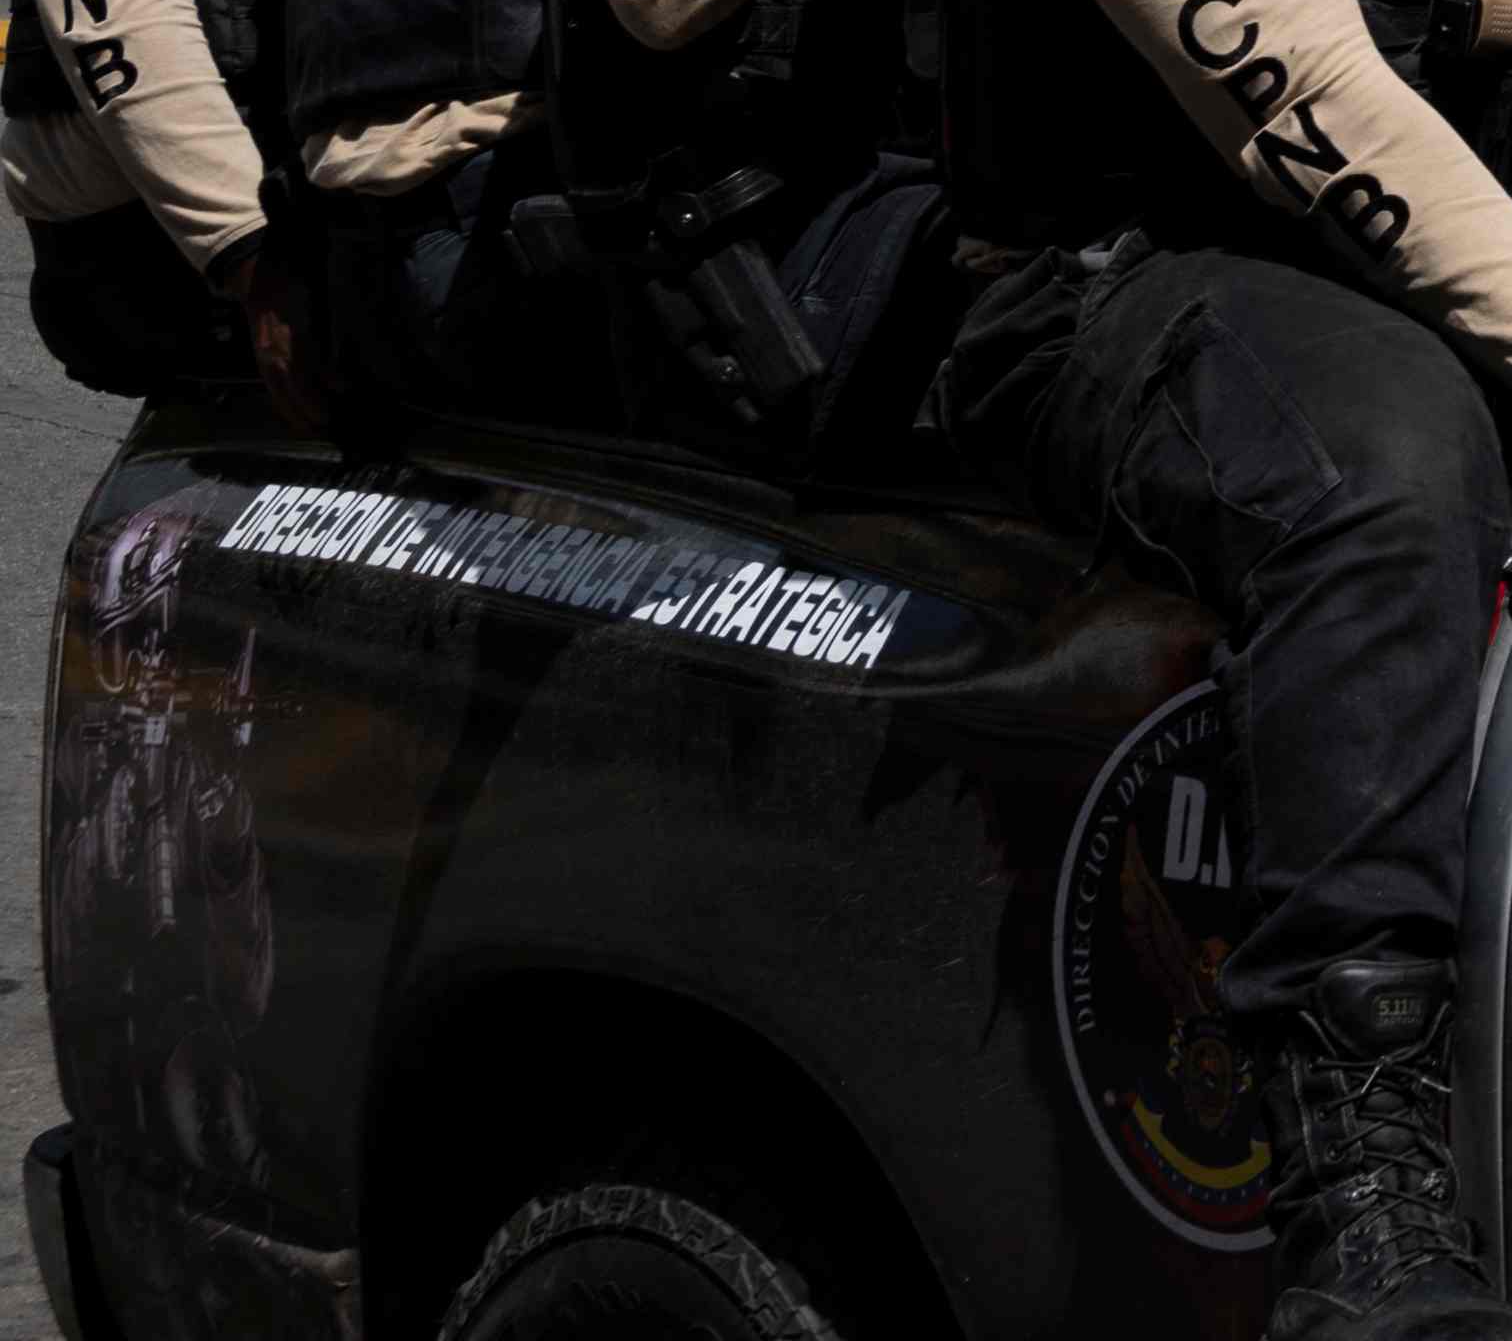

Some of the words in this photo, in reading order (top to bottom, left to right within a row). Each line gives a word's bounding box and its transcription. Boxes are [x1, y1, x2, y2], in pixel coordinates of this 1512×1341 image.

[217, 483, 402, 563] DIRECCION
[367, 498, 452, 571] DE
[415, 504, 654, 615] INTELIGENCIA
[631, 549, 911, 669] ESTRATEGICA
